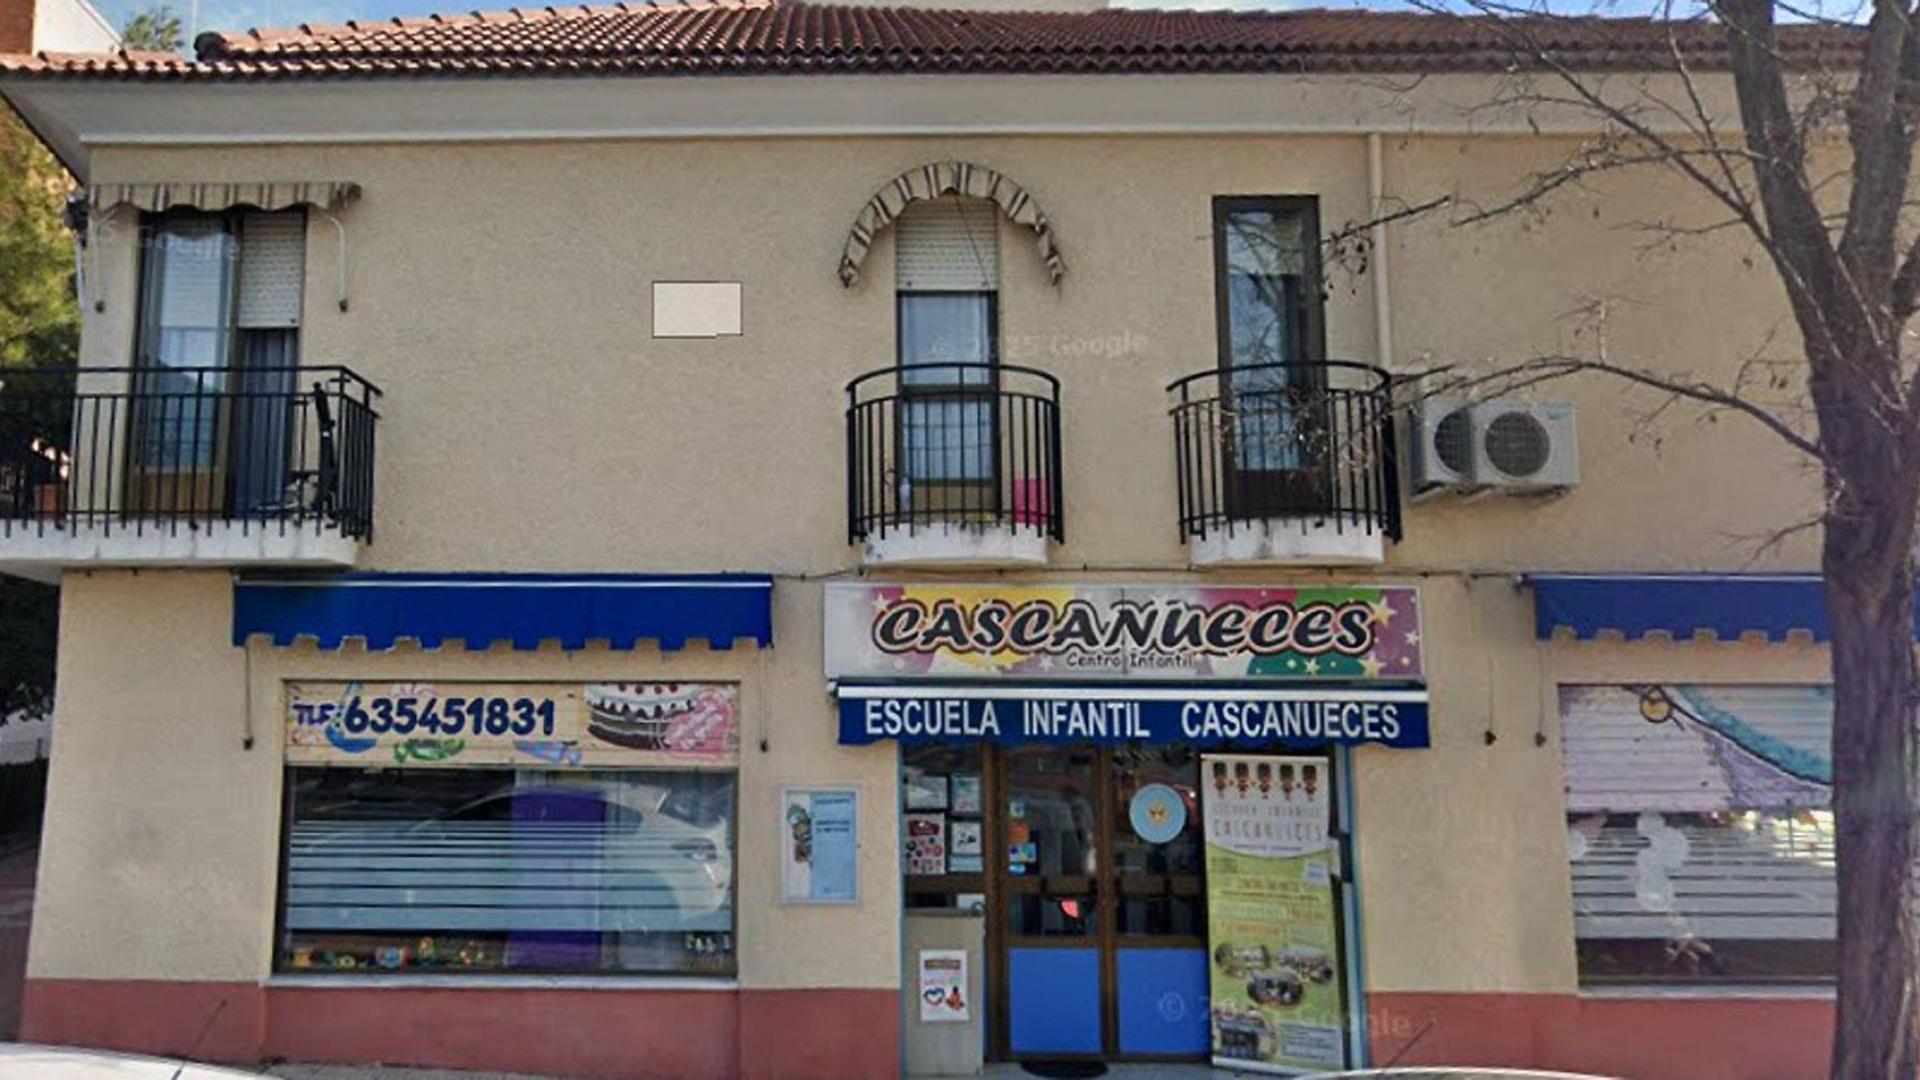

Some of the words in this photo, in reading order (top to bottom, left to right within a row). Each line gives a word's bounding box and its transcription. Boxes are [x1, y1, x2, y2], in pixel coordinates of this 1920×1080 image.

[873, 600, 1376, 657] CASCANUECES
[1066, 652, 1121, 667] Centro
[1129, 652, 1196, 668] Infantil
[345, 696, 555, 735] 635451831
[866, 700, 999, 735] ESCUELA
[1024, 701, 1150, 738] INFANTIL
[1182, 703, 1400, 740] CASCANUECES
